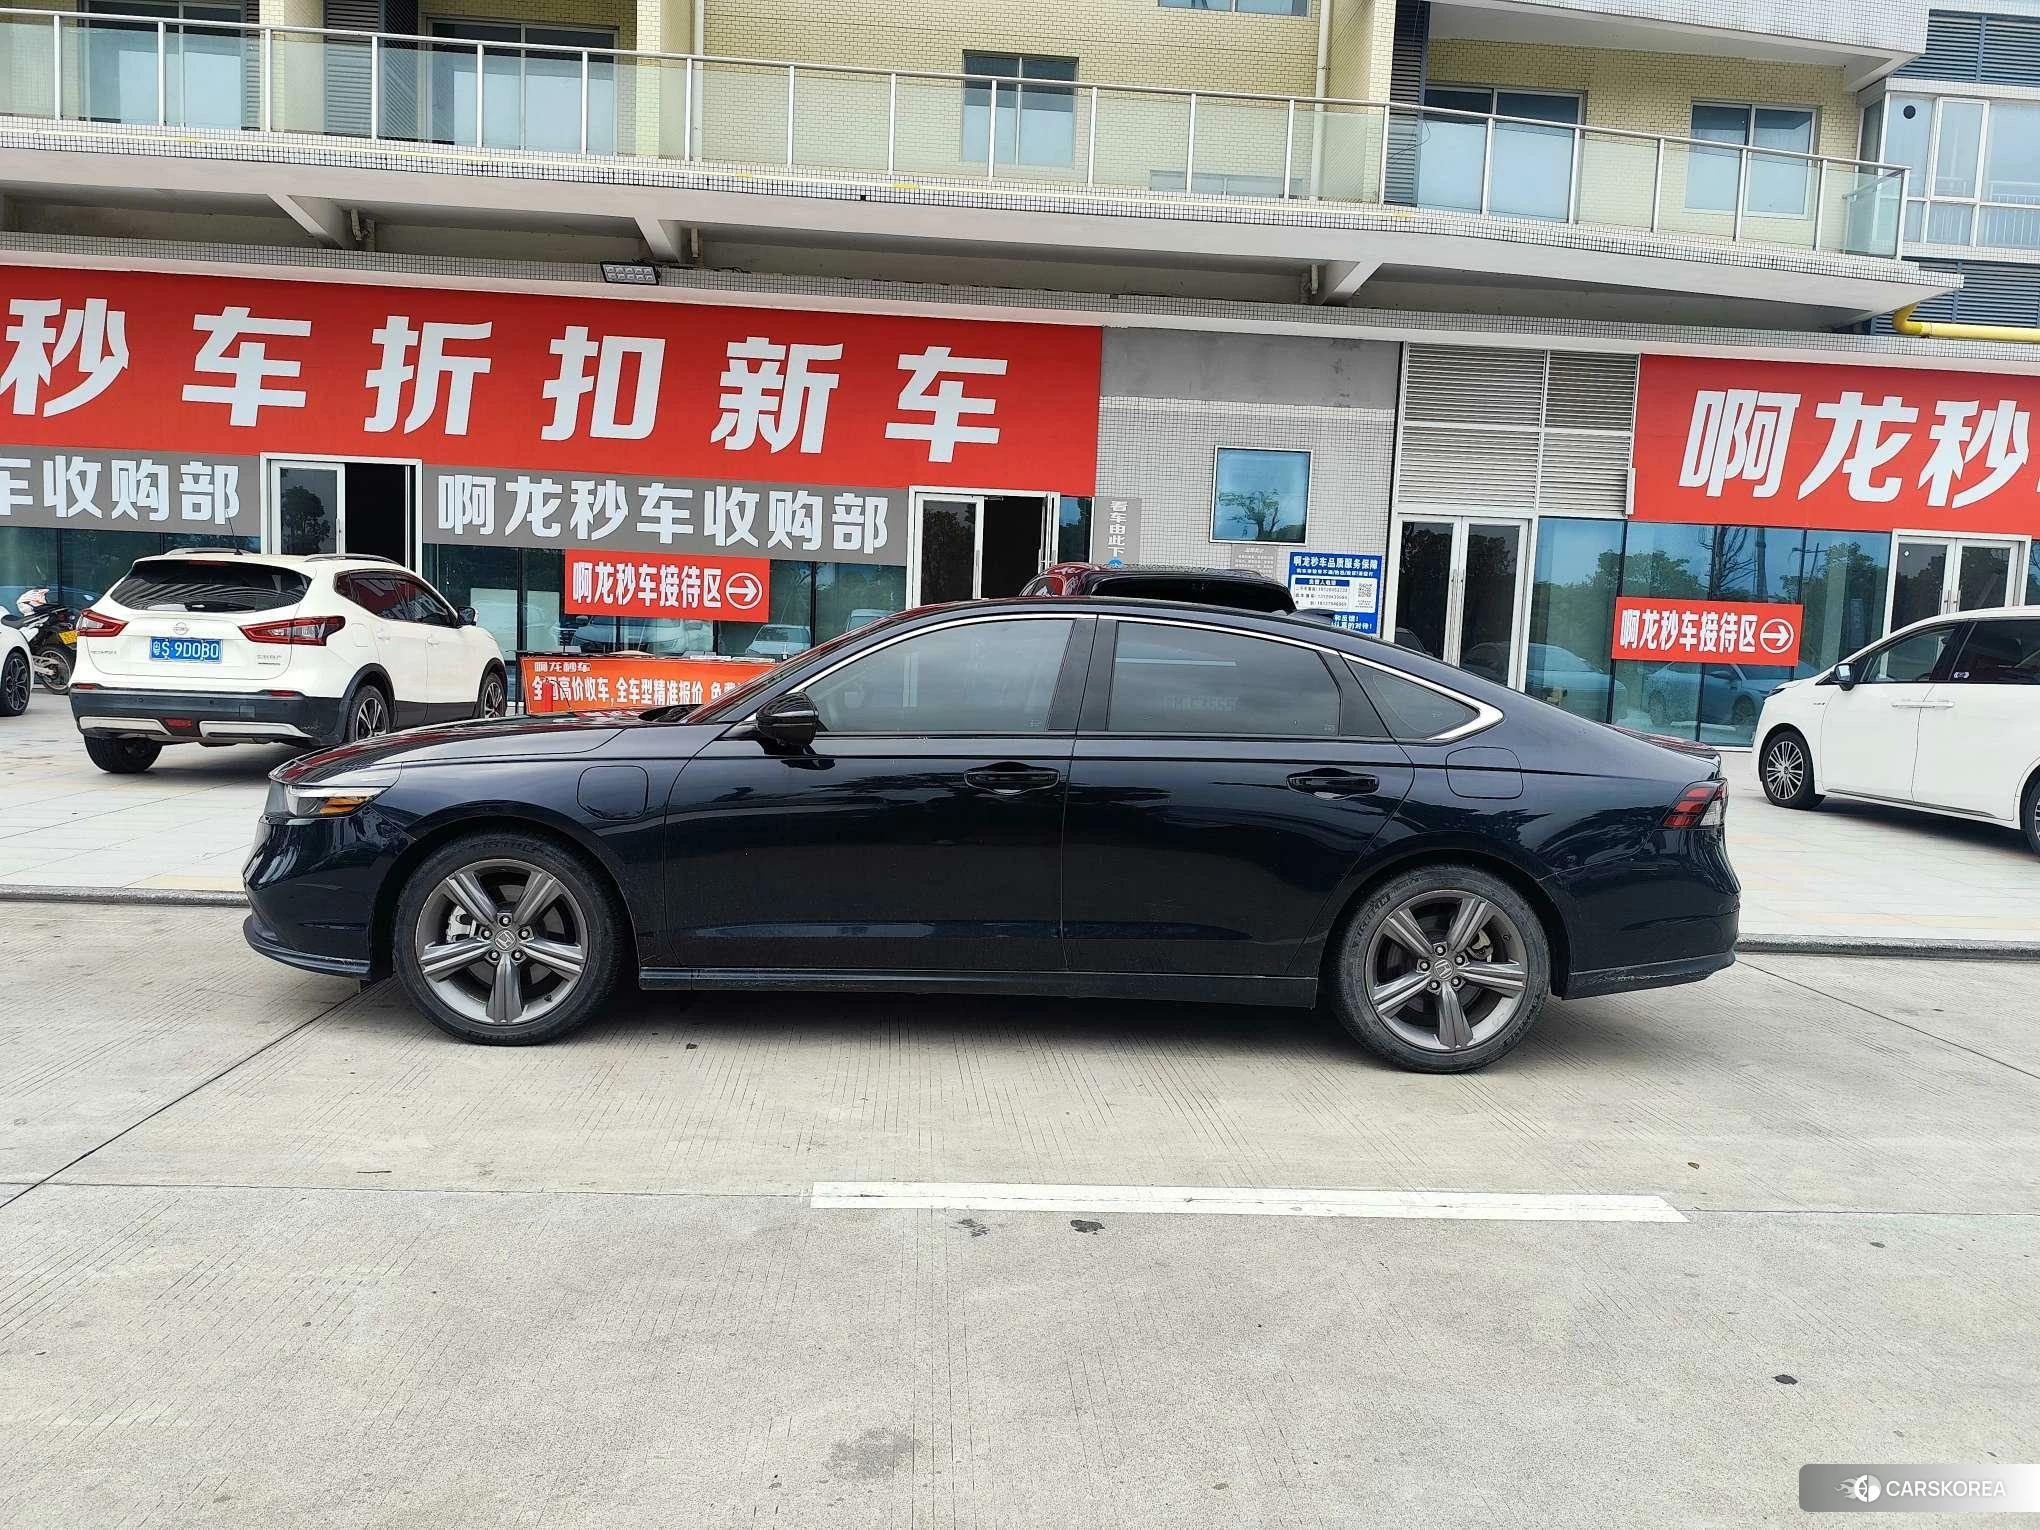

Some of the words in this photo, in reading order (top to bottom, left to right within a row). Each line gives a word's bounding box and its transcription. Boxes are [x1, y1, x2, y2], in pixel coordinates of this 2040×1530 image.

[0, 297, 1008, 463] 秒车折扣新车
[1678, 388, 2040, 509] 啊龙秒
[437, 474, 889, 554] 啊龙秒车收购部
[572, 561, 722, 608] 啊龙秒车接待区
[1293, 556, 1378, 570] 啊龙秒车品质服务保障
[1619, 608, 1758, 653] 啊龙秒车接待区
